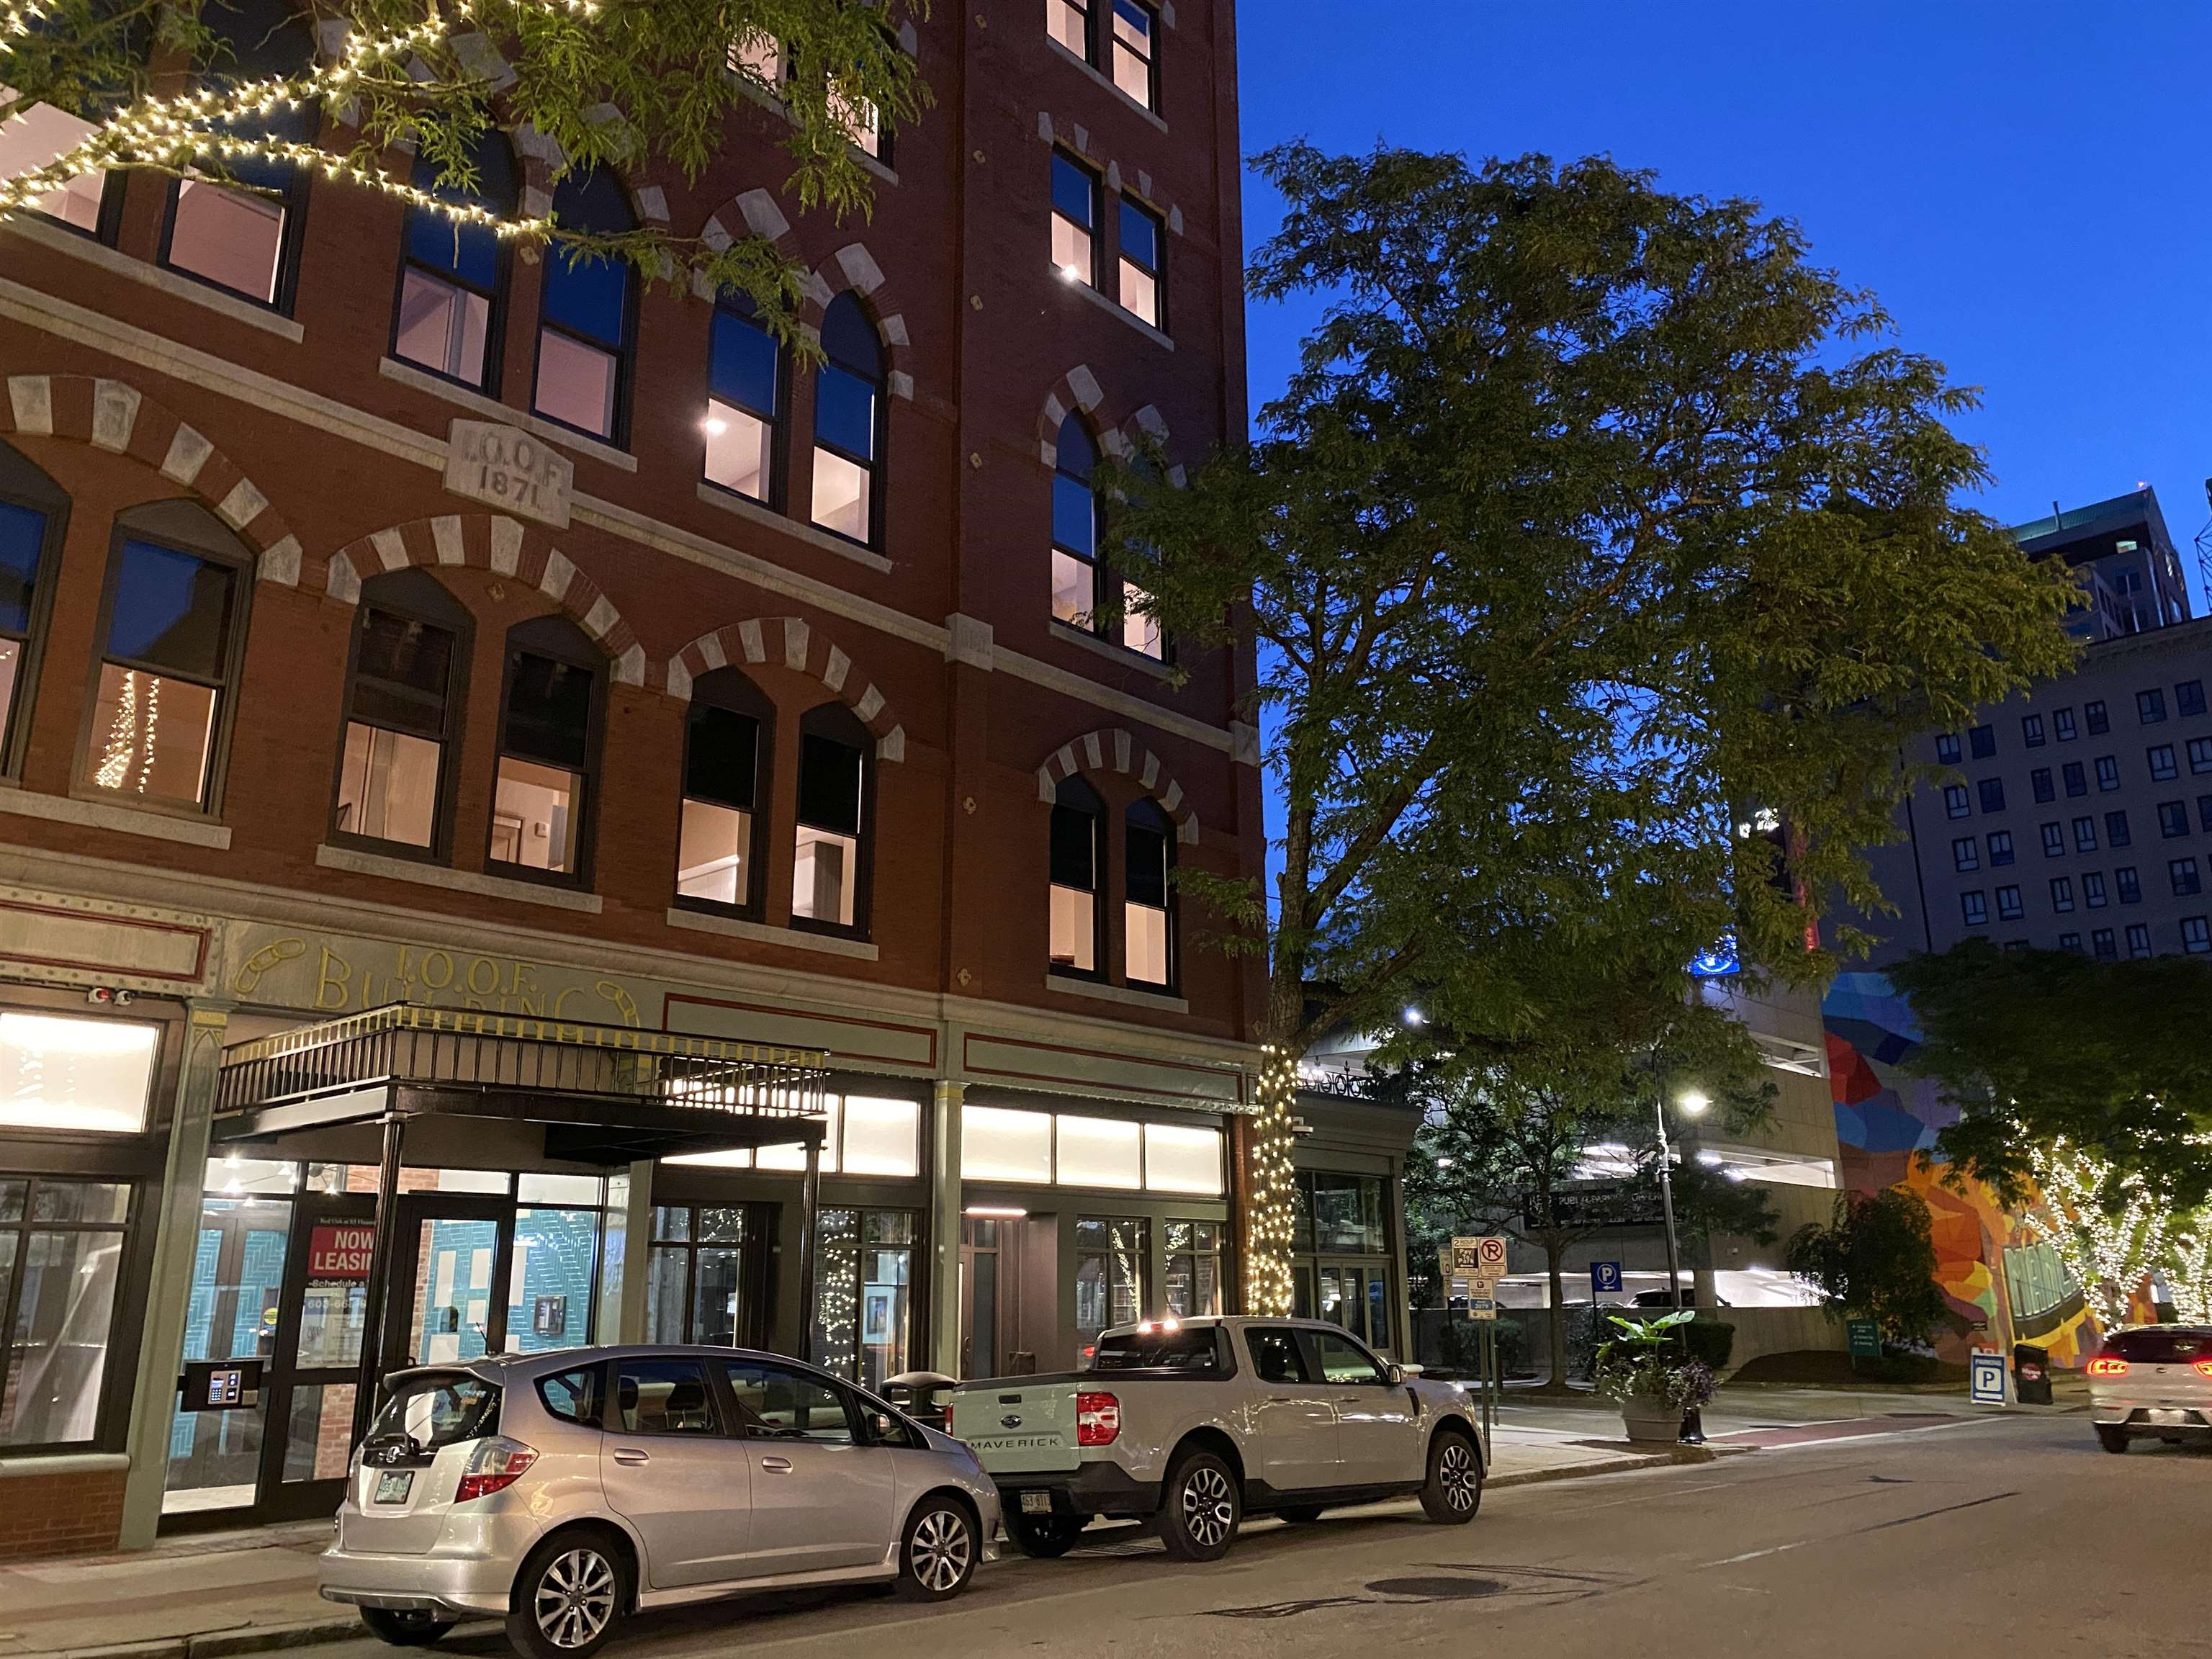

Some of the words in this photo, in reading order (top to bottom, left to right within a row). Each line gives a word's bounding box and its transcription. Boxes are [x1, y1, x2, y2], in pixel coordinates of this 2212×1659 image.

[479, 465, 539, 505] 1871
[334, 1231, 374, 1249] NOW
[314, 1252, 372, 1271] LEASI
[1602, 1267, 1613, 1281] P
[1983, 1370, 1995, 1388] P
[971, 1439, 1058, 1449] MAVERICK
